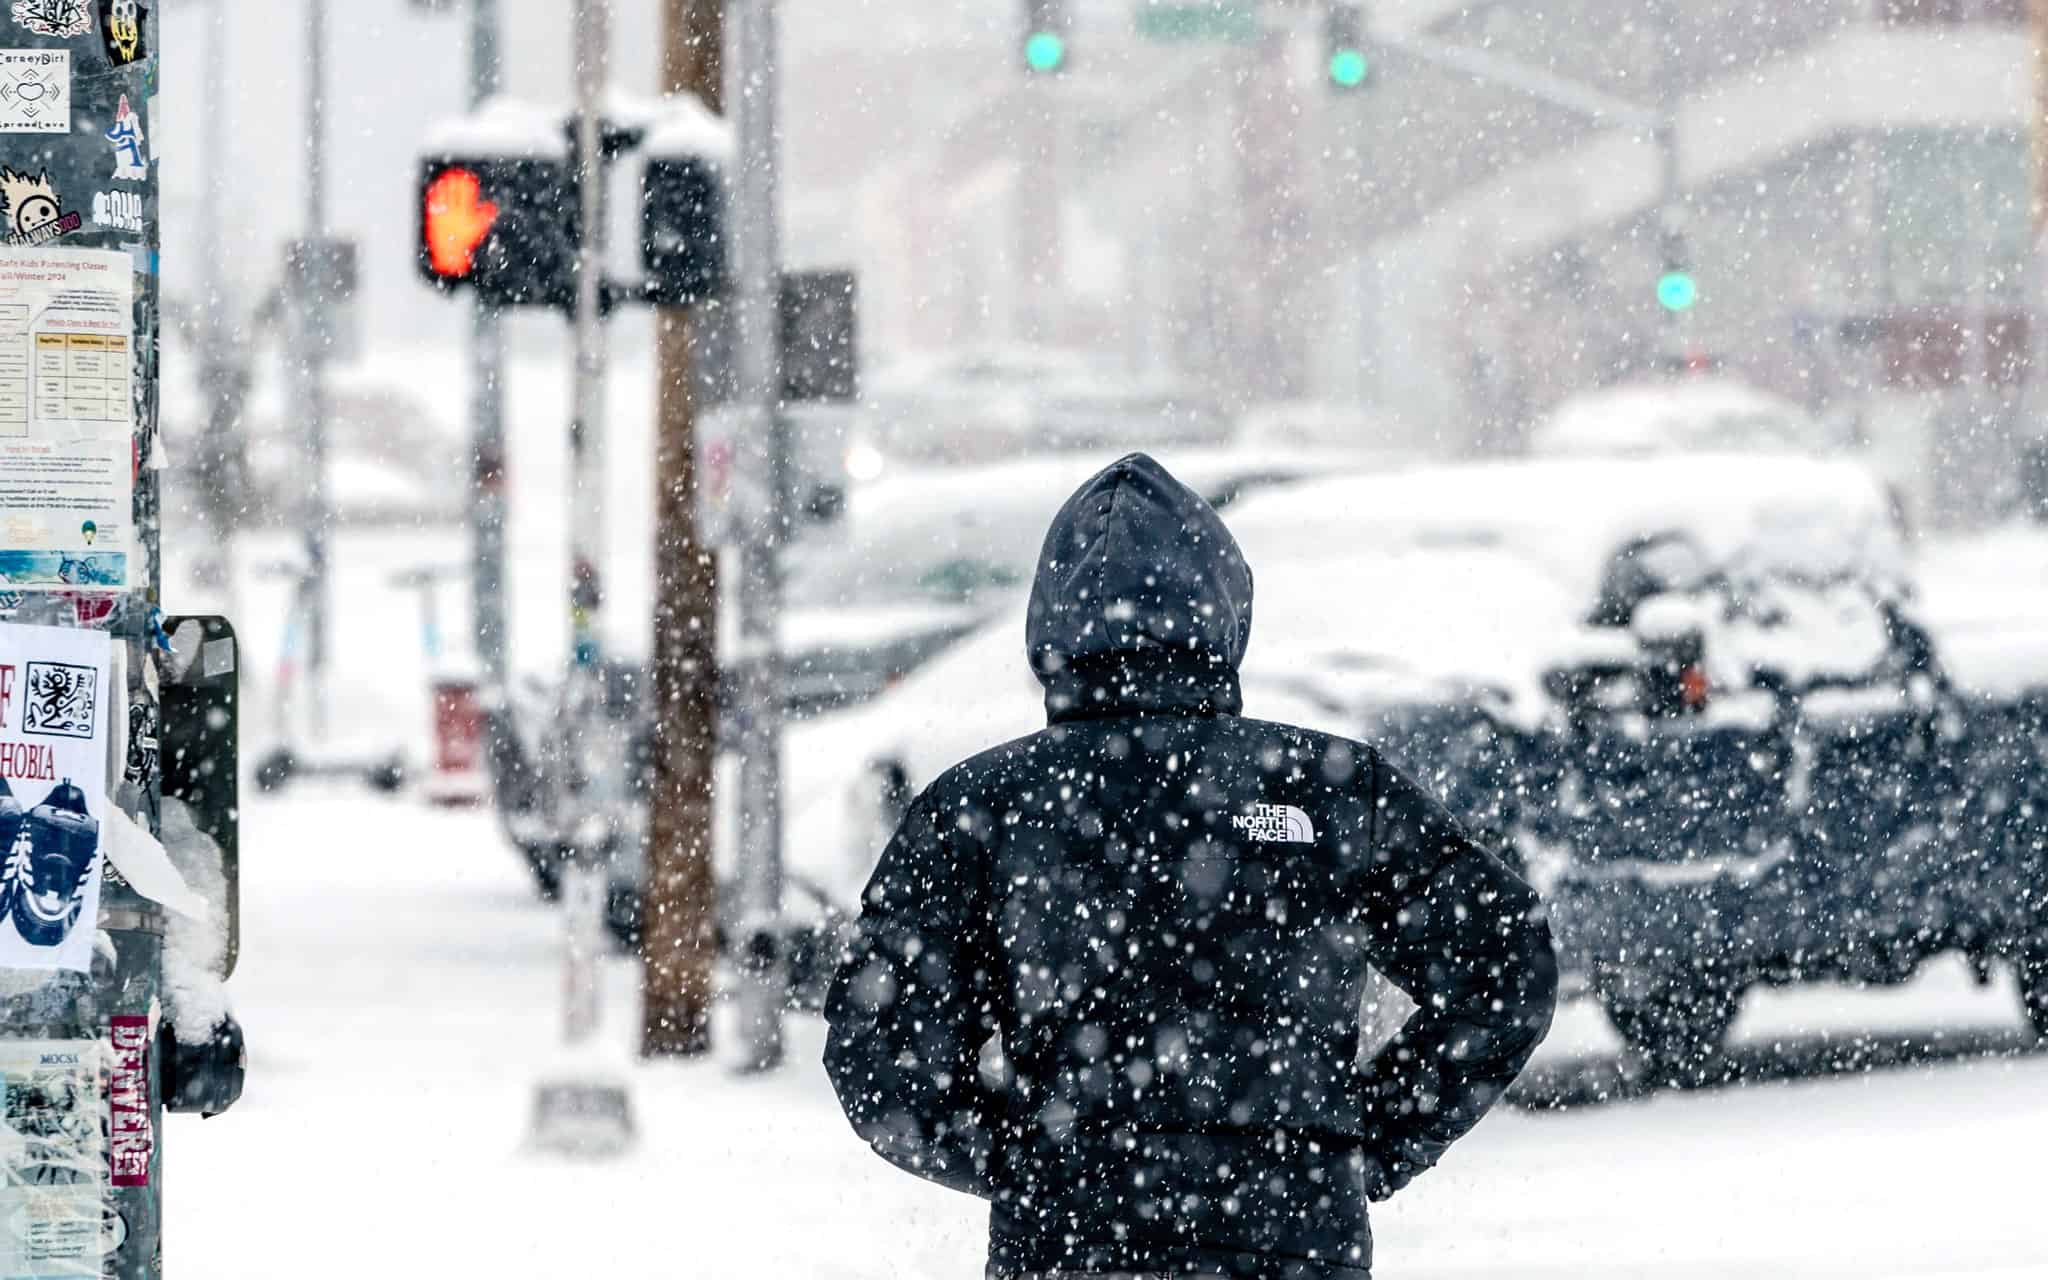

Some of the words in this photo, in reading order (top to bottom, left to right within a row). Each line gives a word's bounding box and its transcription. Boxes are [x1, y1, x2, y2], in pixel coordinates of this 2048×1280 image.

[0, 121, 64, 130] preadLove
[0, 272, 45, 281] all/Winter
[1256, 804, 1287, 817] THE
[1232, 815, 1286, 829] NORTH
[1248, 828, 1287, 842] FACE
[112, 1024, 148, 1152] DENVER
